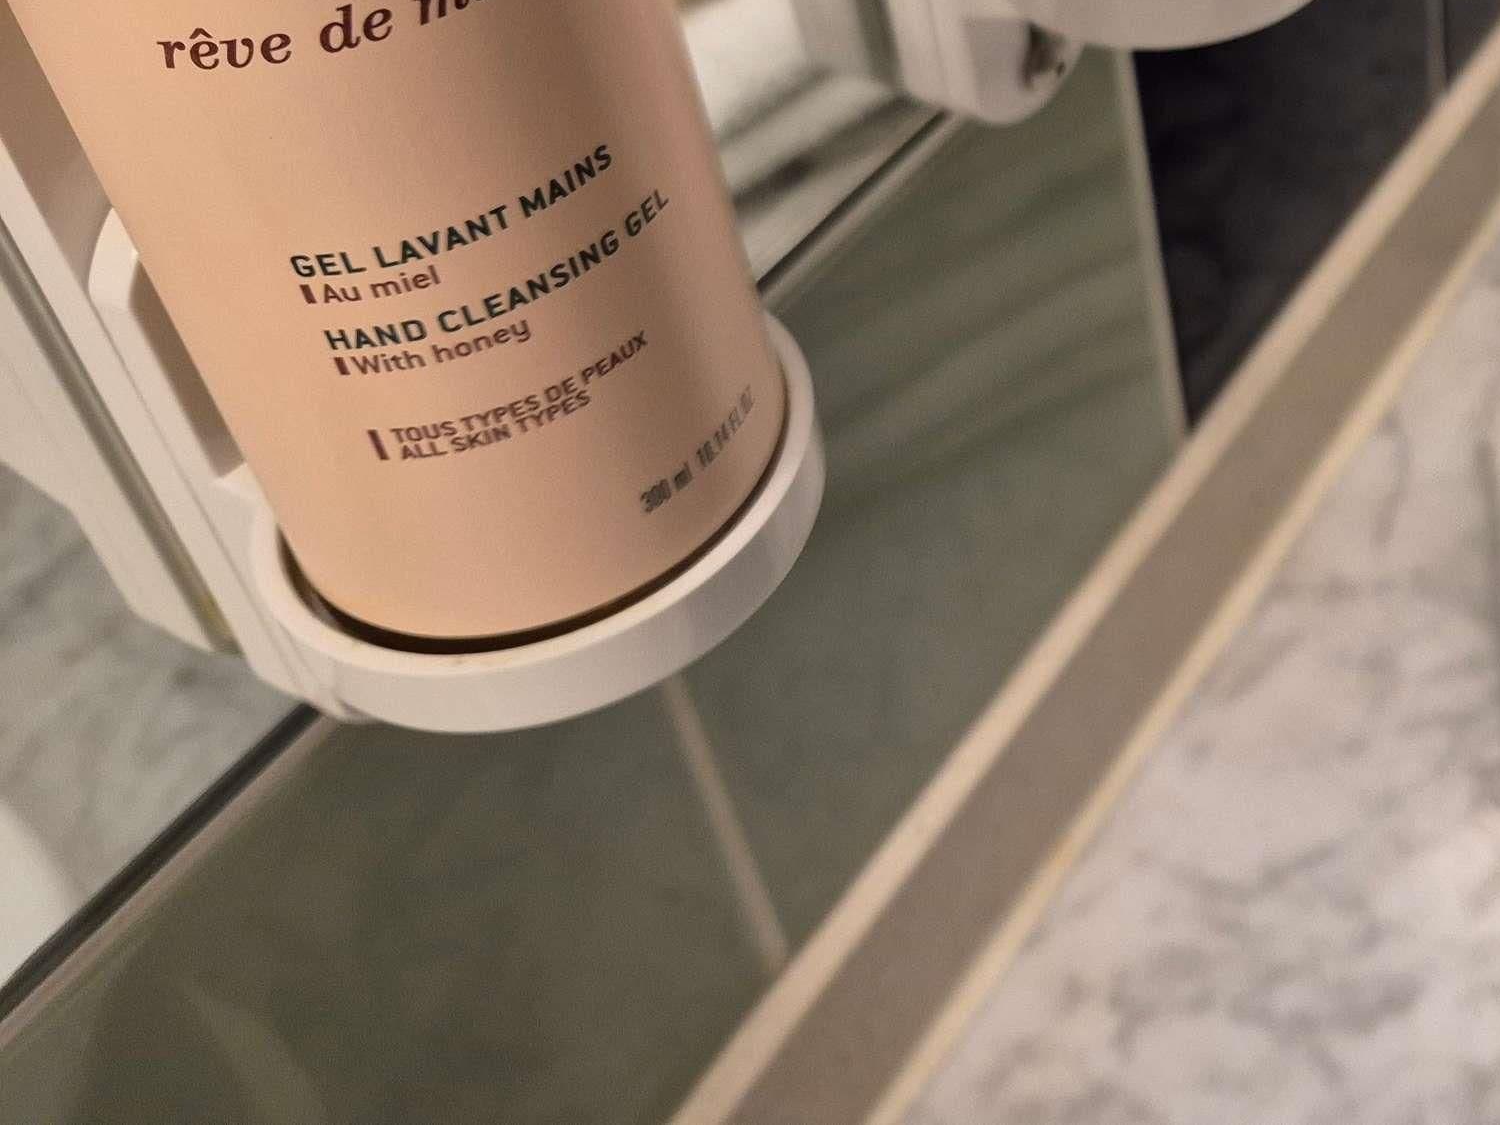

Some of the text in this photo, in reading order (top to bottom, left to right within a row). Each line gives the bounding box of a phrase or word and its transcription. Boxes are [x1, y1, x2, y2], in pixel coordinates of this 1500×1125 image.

[156, 27, 292, 70] rêve
[319, 3, 393, 53] de
[290, 144, 612, 278] GEL LAVANT MAINS
[322, 264, 442, 304] Au miel
[324, 187, 671, 351] HAND CLEANSING GEL
[350, 318, 532, 375] With honey
[389, 330, 650, 443] TOUS TYPES DE PEAUX
[400, 389, 592, 461] ALL SKIN TYPES
